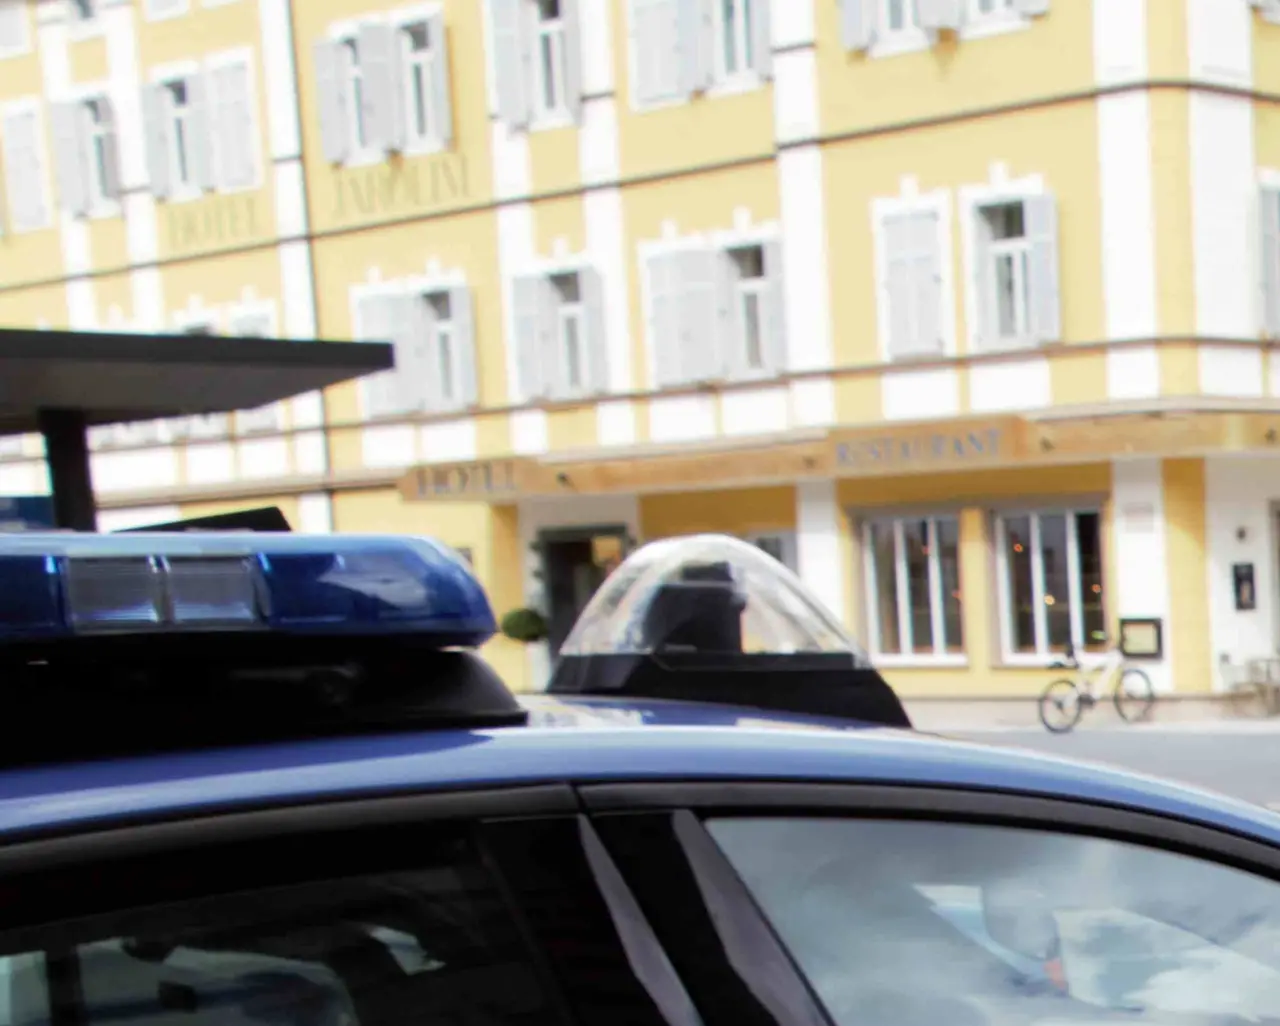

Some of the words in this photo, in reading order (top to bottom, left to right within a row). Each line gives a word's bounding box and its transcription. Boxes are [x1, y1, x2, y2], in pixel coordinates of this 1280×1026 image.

[167, 196, 258, 245] HOTEL
[837, 428, 1002, 466] RESTAURANT
[416, 461, 516, 496] HOTEL
